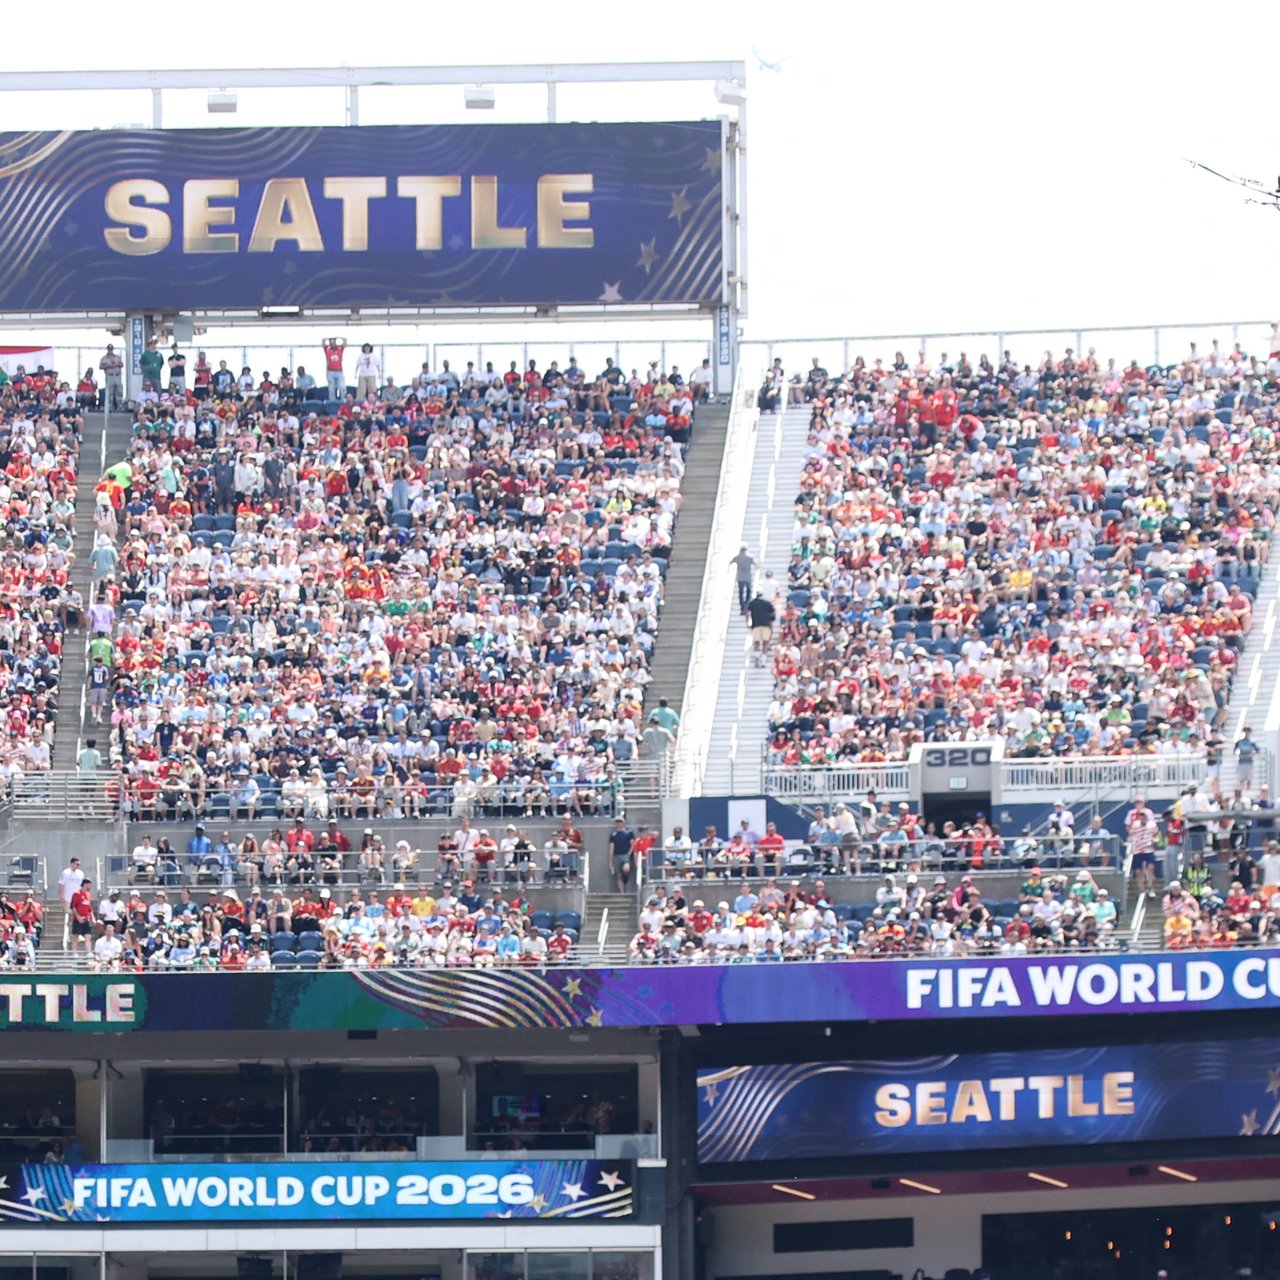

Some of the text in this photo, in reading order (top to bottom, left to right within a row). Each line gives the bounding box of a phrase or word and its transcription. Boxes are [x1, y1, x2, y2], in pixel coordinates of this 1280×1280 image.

[103, 174, 596, 255] SEATTLE
[926, 748, 991, 767] 320
[906, 965, 1021, 1010] FIFA
[1028, 958, 1223, 1006] WORLD
[874, 1071, 1135, 1127] SEATTLE
[73, 1172, 535, 1208] FIFA WORLD CUP 2026
